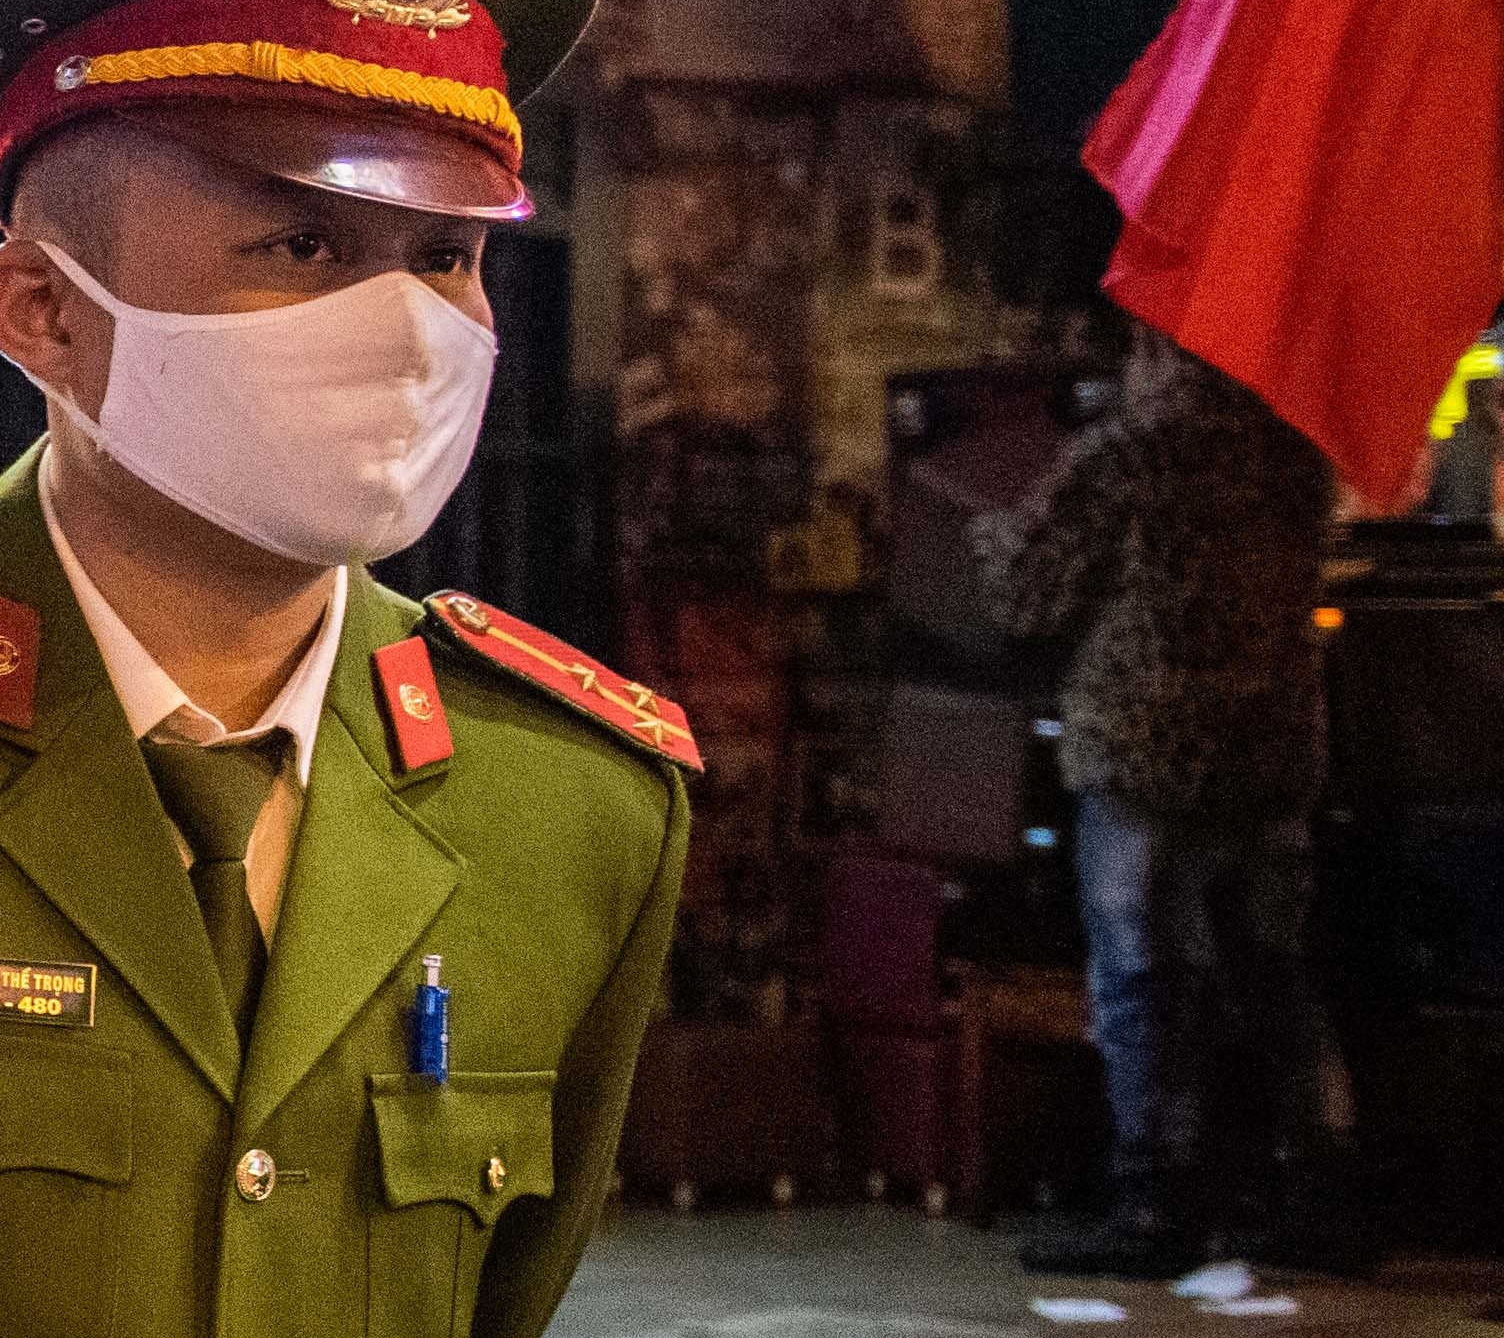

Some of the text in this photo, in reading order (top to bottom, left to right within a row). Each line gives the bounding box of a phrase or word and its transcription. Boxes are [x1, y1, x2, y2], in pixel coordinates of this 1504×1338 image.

[2, 966, 31, 989] THẾ
[33, 973, 85, 997] TRỌNG
[17, 996, 62, 1016] 480
